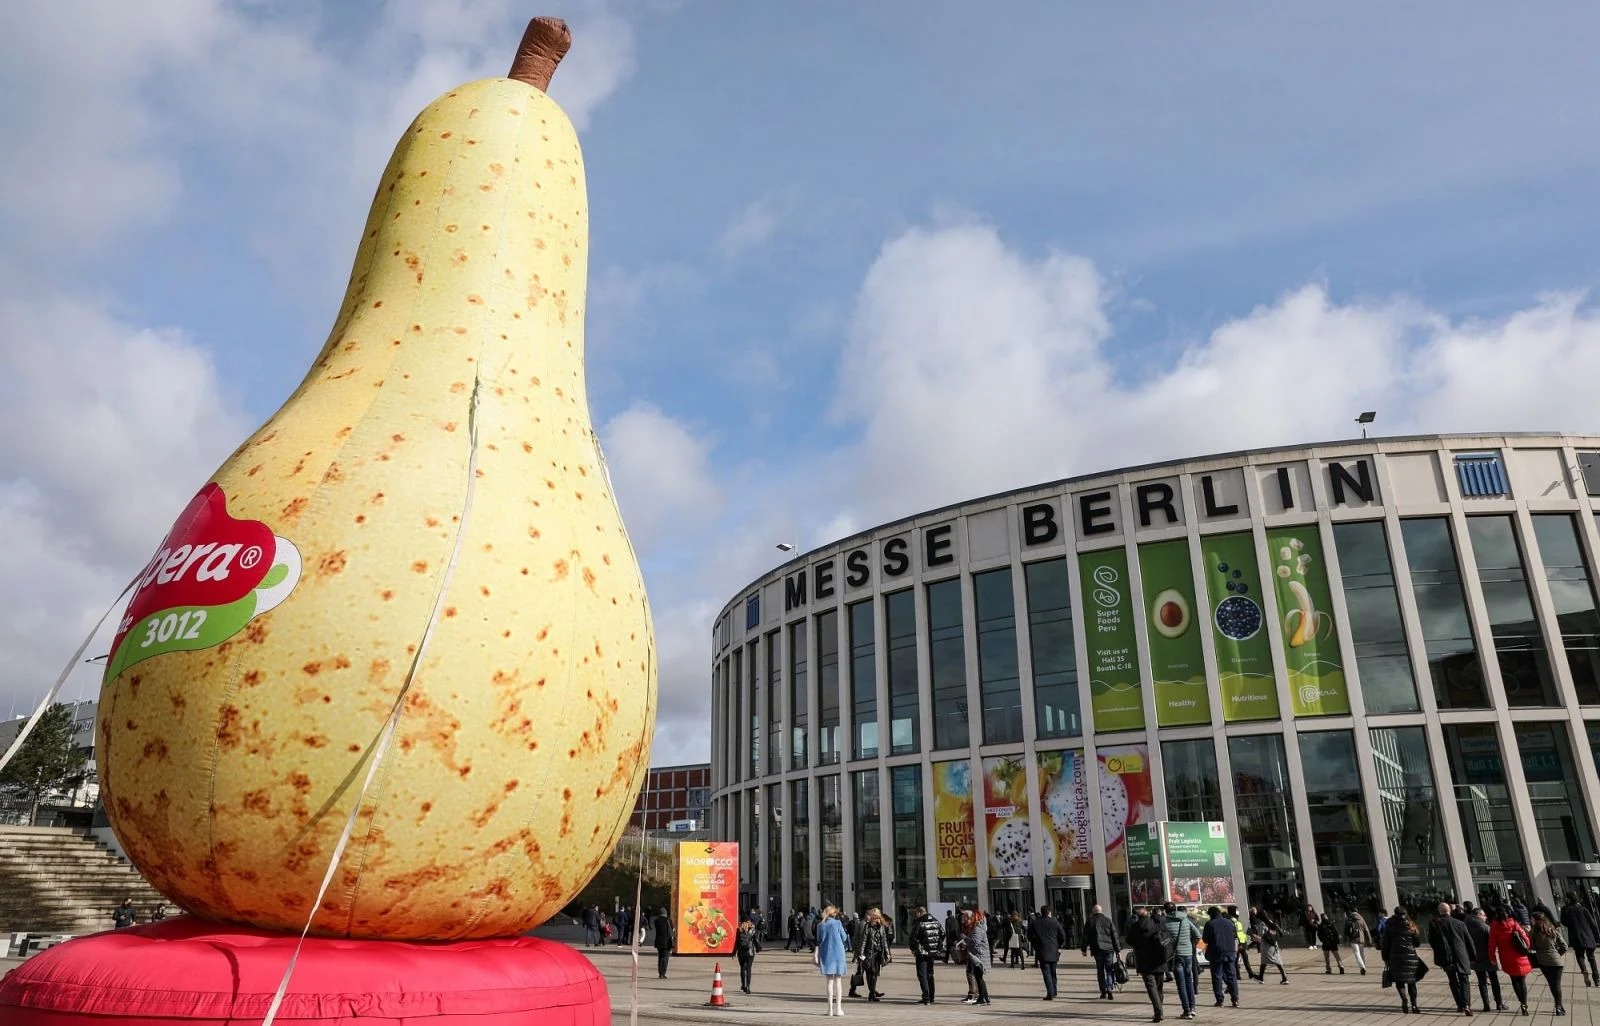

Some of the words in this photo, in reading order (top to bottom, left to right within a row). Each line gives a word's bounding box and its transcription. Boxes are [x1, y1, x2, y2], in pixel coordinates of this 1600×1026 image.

[785, 524, 954, 611] MESSE
[1022, 460, 1374, 547] BERLIN
[141, 610, 208, 648] 3012
[1168, 699, 1196, 707] Healthy
[1231, 692, 1268, 703] Nutritious
[1073, 759, 1089, 864] fruitlogistica.com
[938, 822, 973, 833] FRUIT
[939, 834, 974, 846] LOGIS
[940, 846, 968, 858] TICA
